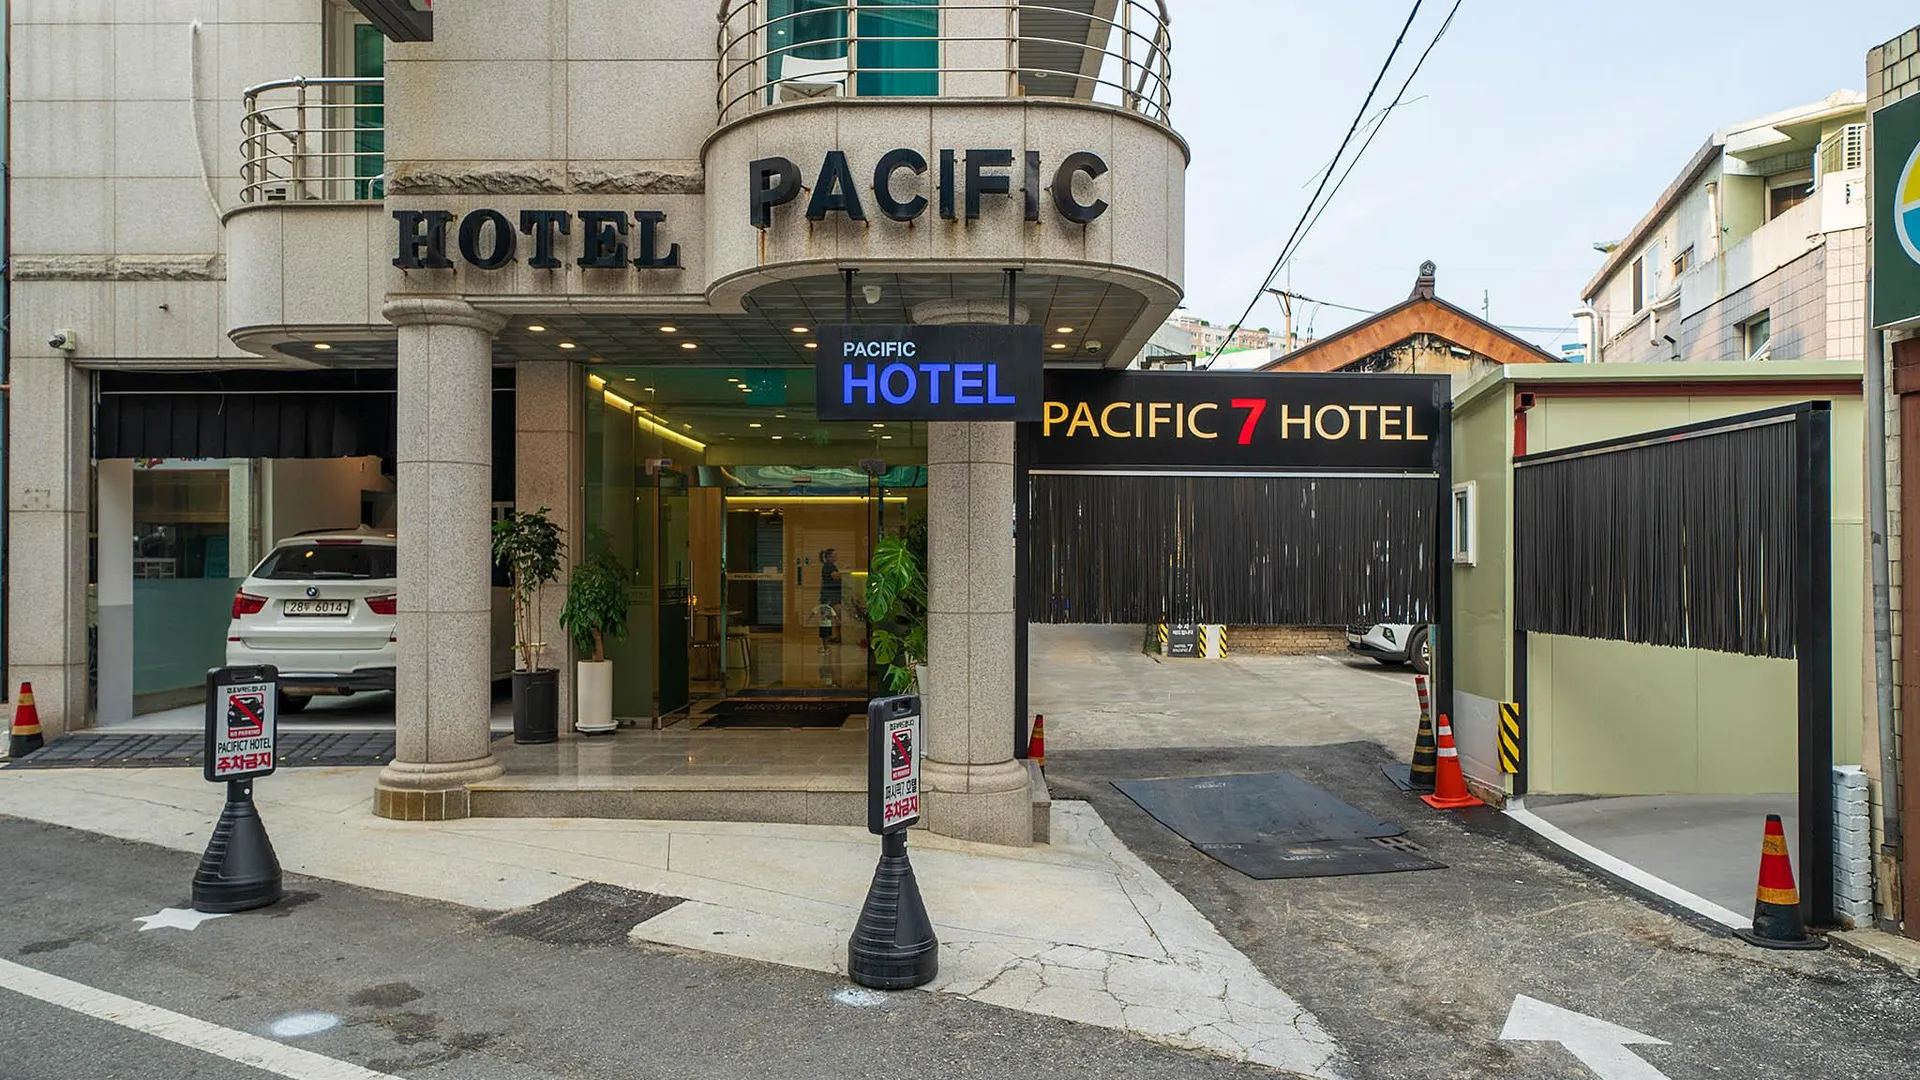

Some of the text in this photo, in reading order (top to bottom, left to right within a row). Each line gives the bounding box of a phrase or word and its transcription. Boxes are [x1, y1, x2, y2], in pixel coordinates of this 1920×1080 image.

[750, 149, 1109, 227] PACIFIC
[393, 209, 681, 270] HOTEL
[842, 342, 916, 357] PACIFIC
[843, 363, 1016, 405] HOTEL
[1042, 398, 1428, 445] PACIFIC 7 HOTEL
[315, 602, 342, 612] 6014
[1187, 643, 1193, 652] 7
[250, 738, 271, 749] HOTEL
[217, 752, 271, 773] 주차금지
[884, 795, 918, 822] 주차금지
